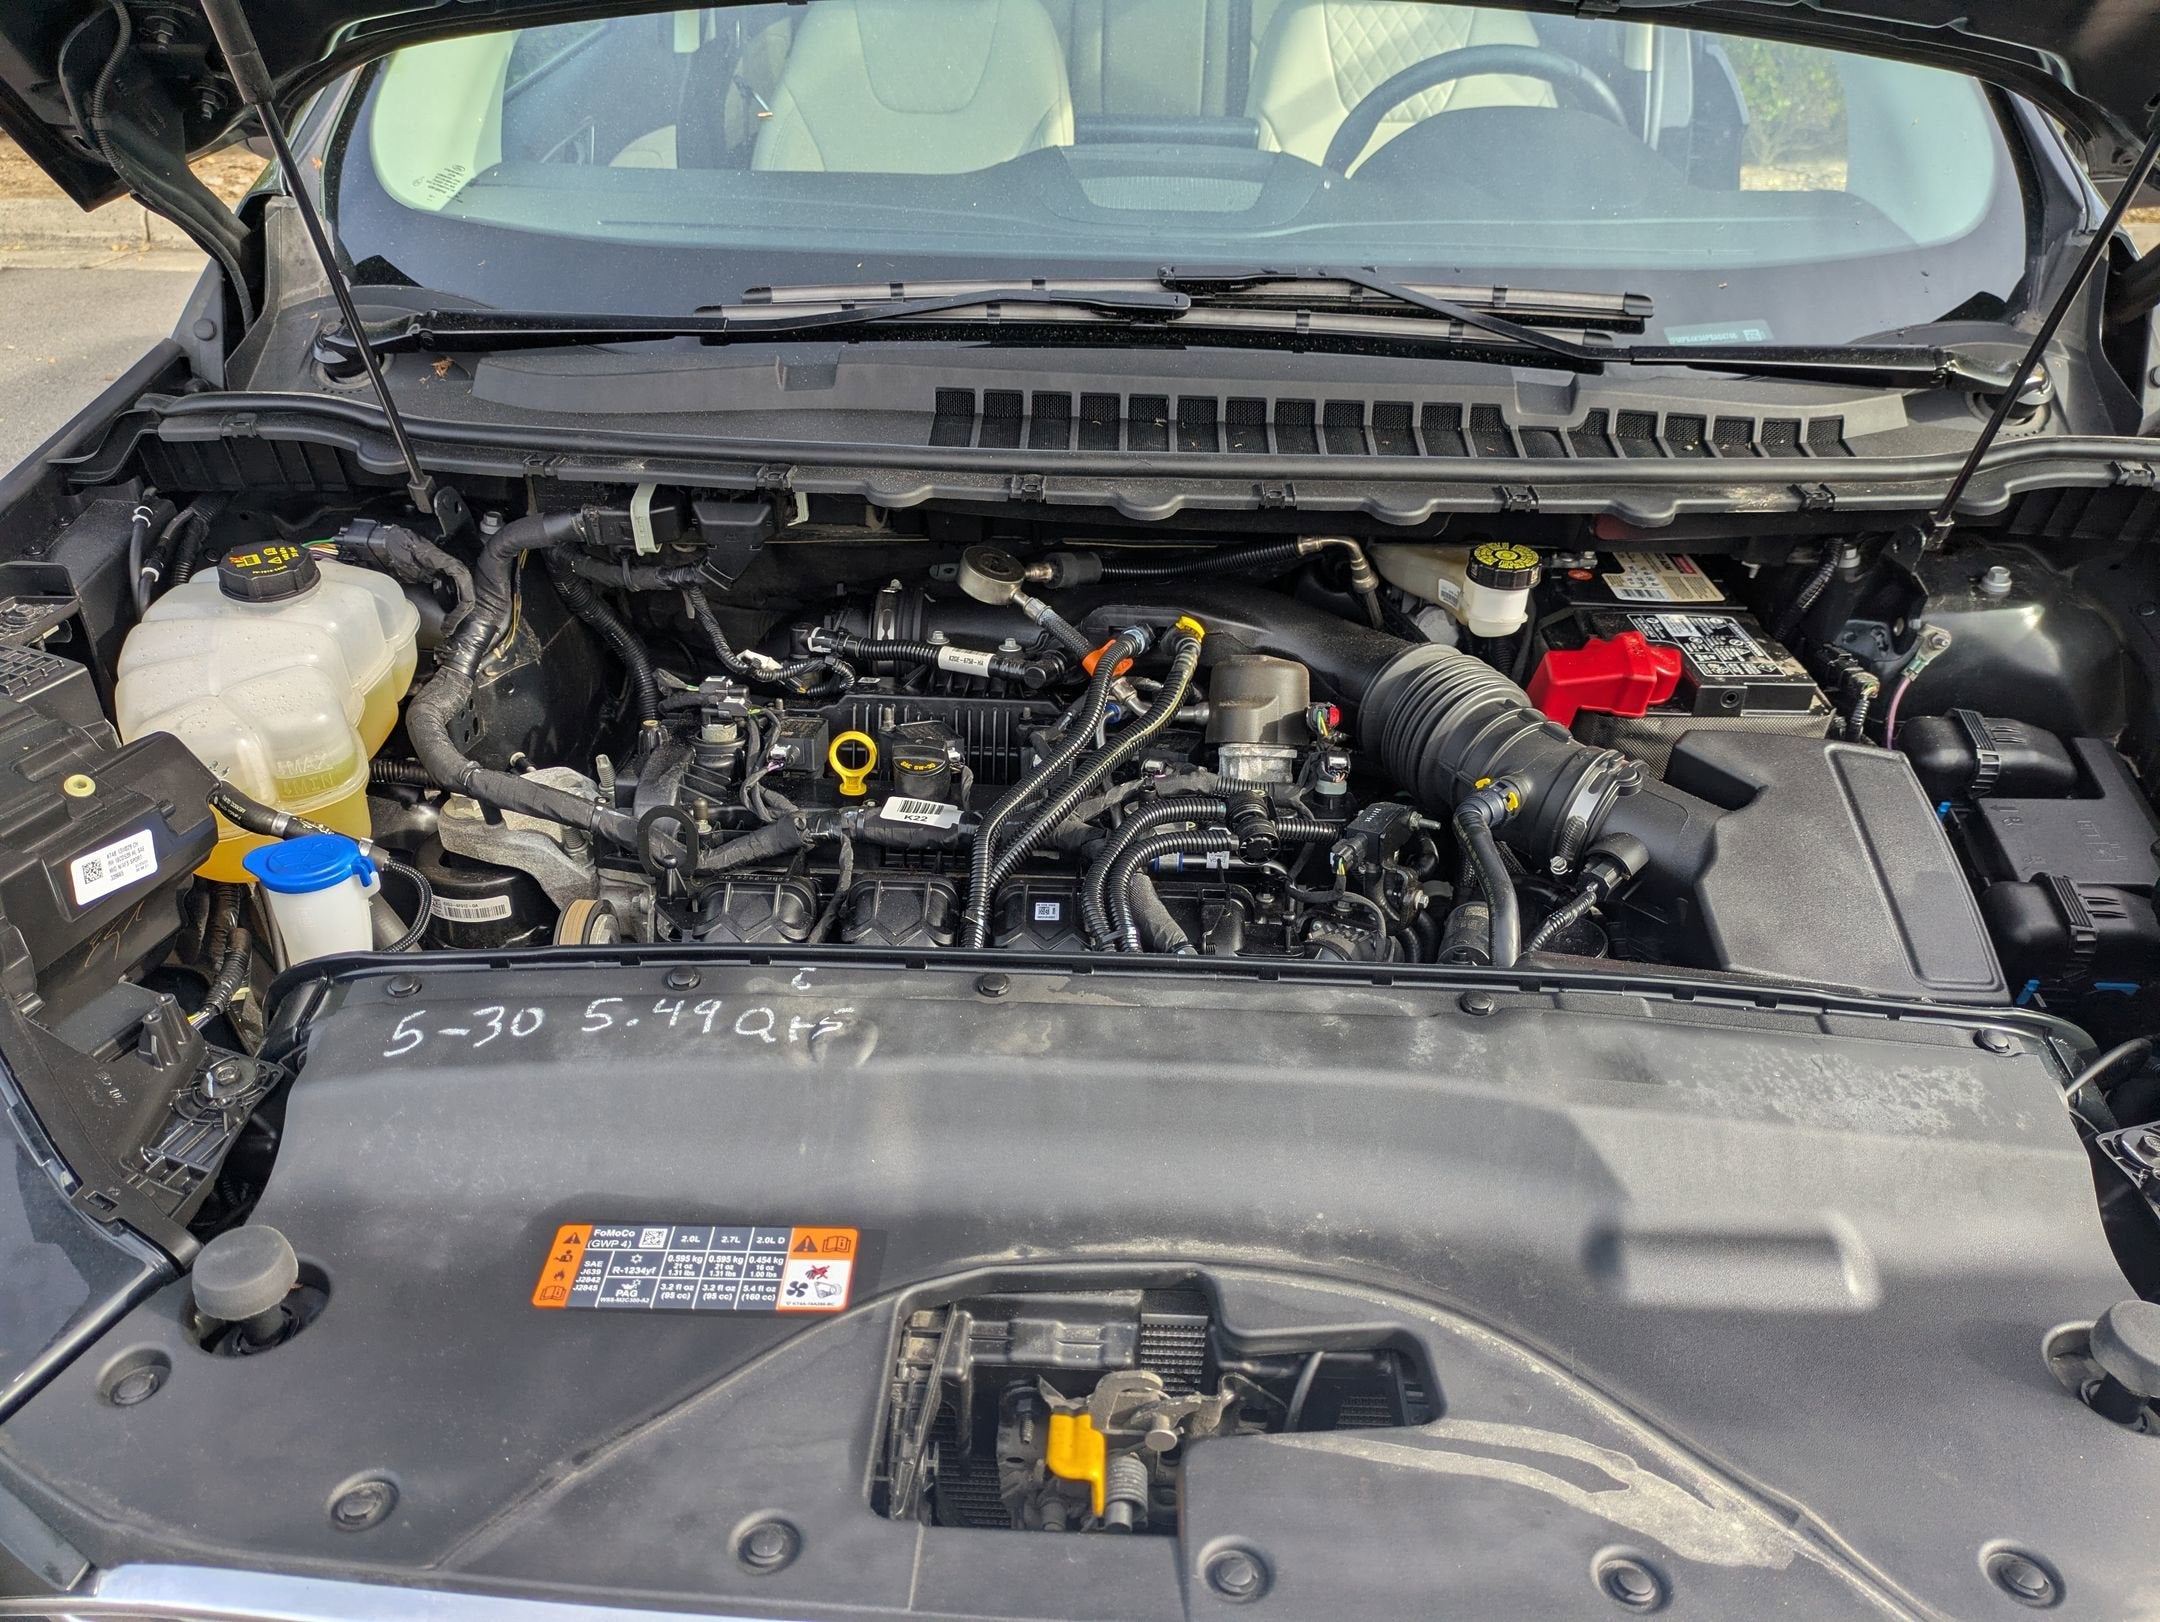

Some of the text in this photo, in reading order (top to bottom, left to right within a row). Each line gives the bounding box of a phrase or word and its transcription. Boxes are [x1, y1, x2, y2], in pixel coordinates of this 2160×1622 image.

[286, 753, 328, 775] MAX
[293, 773, 334, 795] MIN
[903, 814, 929, 823] K22
[383, 1005, 546, 1058] 5-30
[581, 997, 722, 1035] 5.49
[593, 1229, 636, 1237] FoMoCo
[587, 1239, 632, 1249] (GWP 4)
[680, 1235, 701, 1244] 2.0L
[720, 1236, 741, 1244] 2.7L
[756, 1236, 786, 1245] 2.0L D
[583, 1260, 604, 1268] SAE
[667, 1254, 704, 1265] 0.595 kg
[708, 1255, 744, 1266] 0.595 kg
[748, 1256, 784, 1266] 0.454 kg
[580, 1268, 602, 1276] J639
[612, 1266, 657, 1276] R-1234yf
[660, 1283, 674, 1291] 3.2
[675, 1283, 682, 1291] fl
[615, 1289, 638, 1298] PAG
[660, 1292, 691, 1300] (95 cc)
[703, 1292, 733, 1301] (95 cc)
[741, 1293, 776, 1302] (160 cc)
